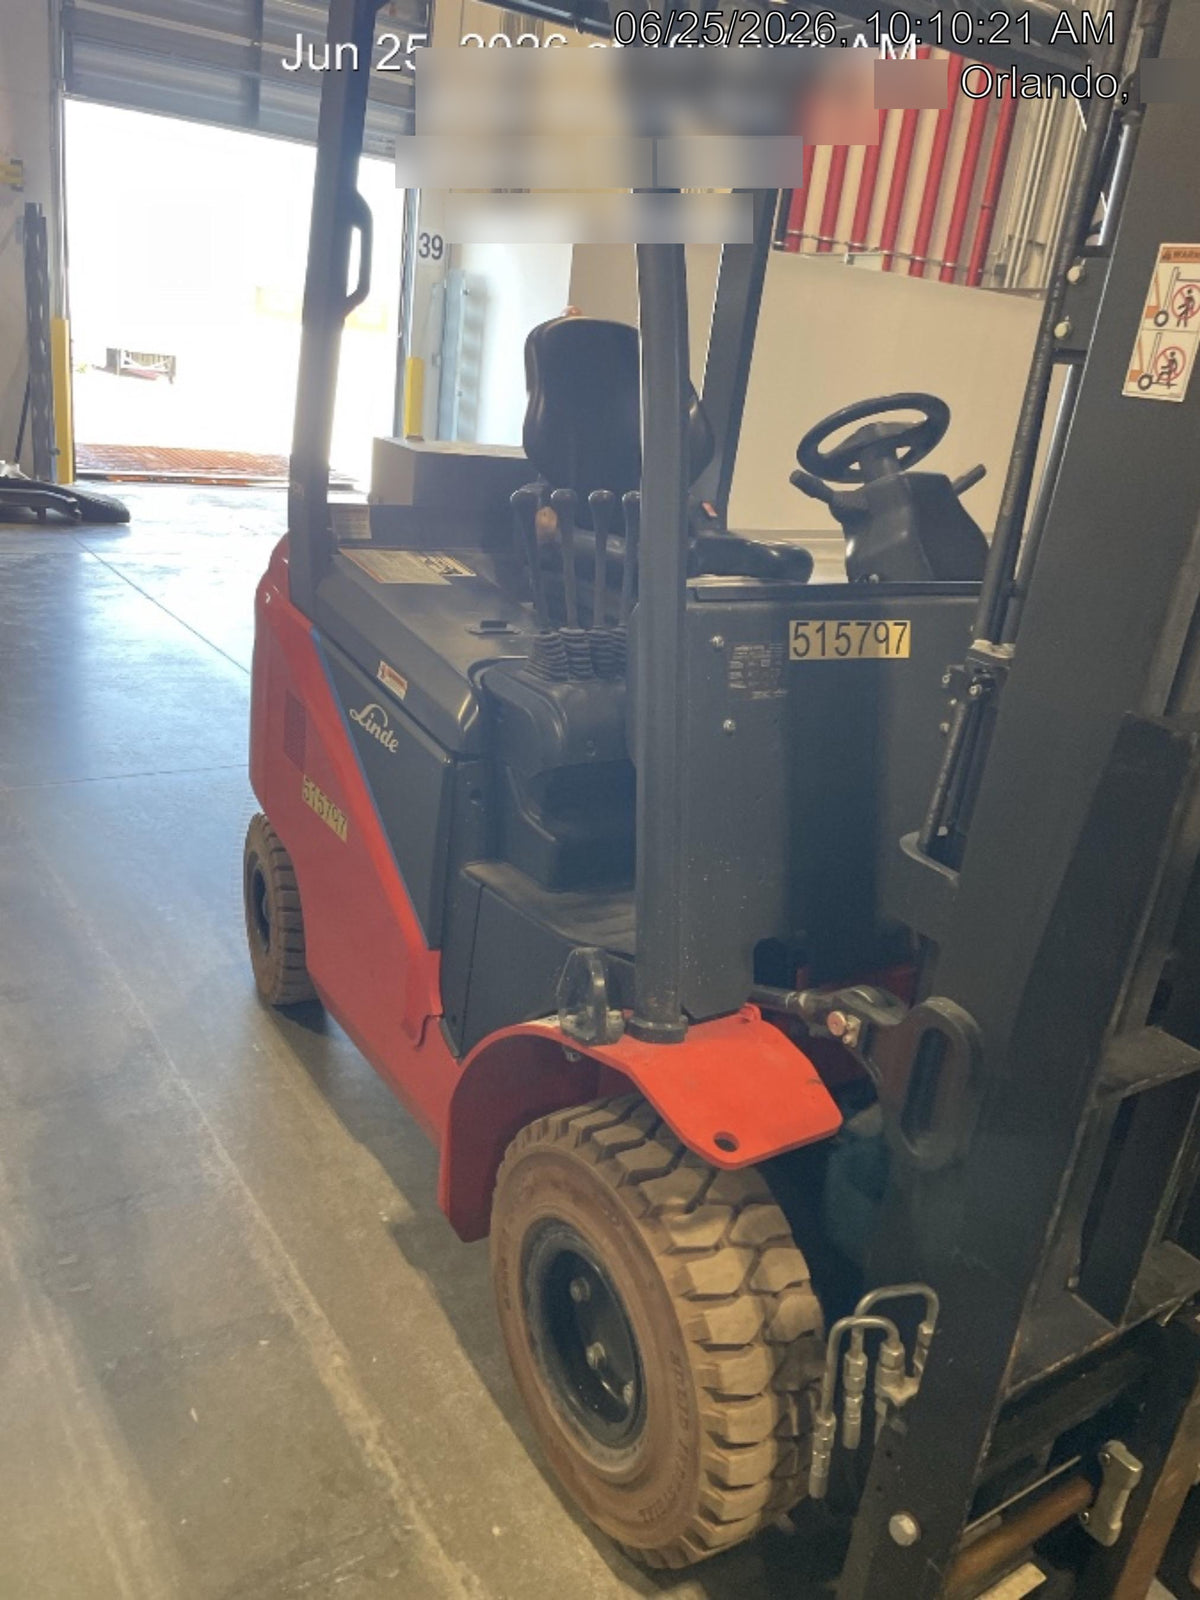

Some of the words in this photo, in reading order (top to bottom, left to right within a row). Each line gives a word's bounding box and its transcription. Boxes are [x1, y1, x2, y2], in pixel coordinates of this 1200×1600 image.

[418, 232, 444, 260] 39
[792, 621, 908, 658] 515797
[349, 703, 399, 753] Linde
